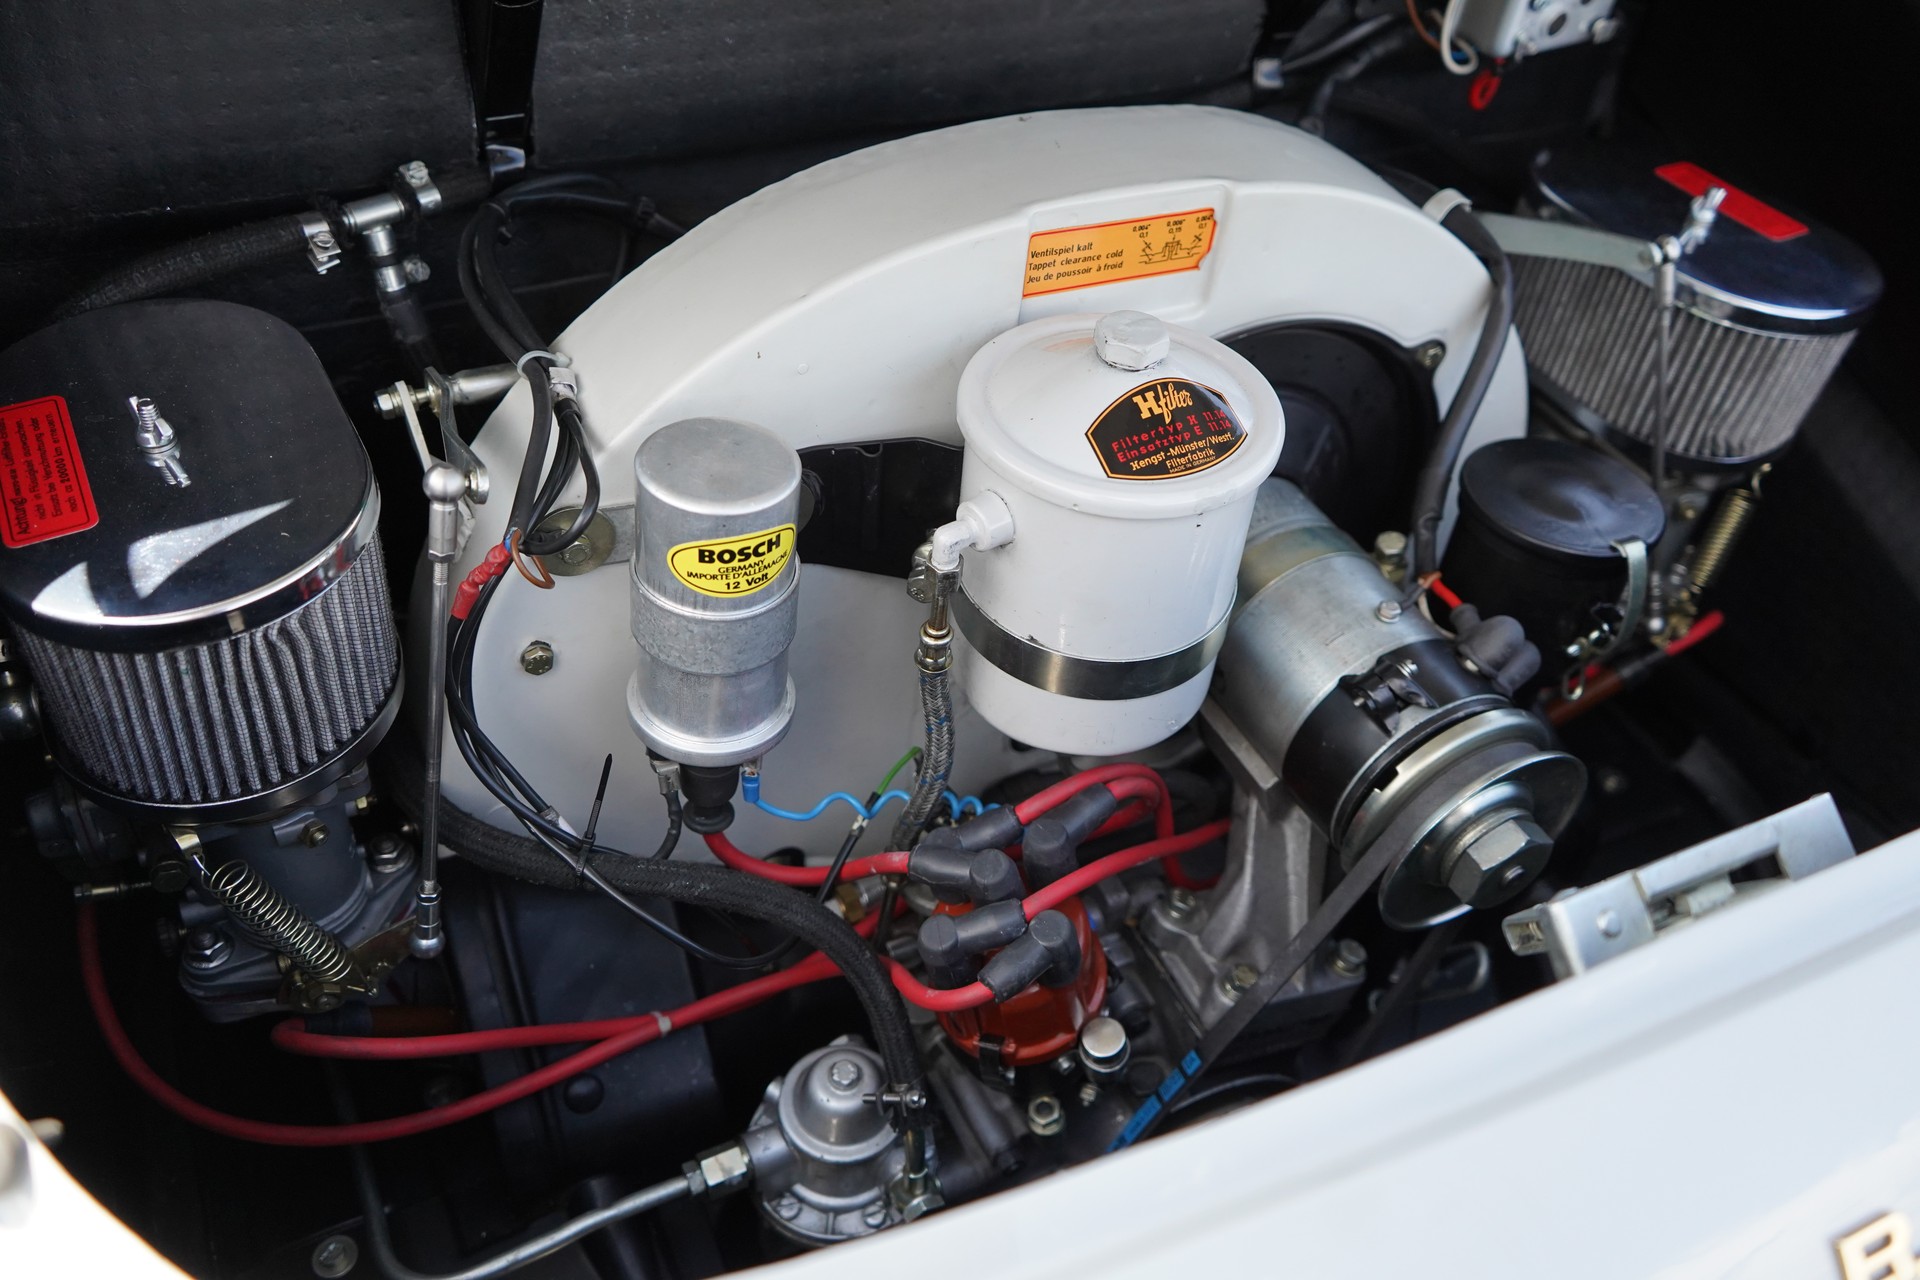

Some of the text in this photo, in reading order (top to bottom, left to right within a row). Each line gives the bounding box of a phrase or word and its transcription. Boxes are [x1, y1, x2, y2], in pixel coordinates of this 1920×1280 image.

[1028, 249, 1124, 271] Tappet clearance cold
[1030, 242, 1093, 259] Ventilspiel kalt
[1027, 260, 1124, 284] Jeu de poussoir à froid
[1112, 422, 1183, 452] Filtertyp
[1203, 409, 1226, 421] 11.14
[1117, 420, 1232, 463] Einsatztyp E 11.14
[54, 446, 64, 459] km
[1166, 448, 1216, 469] Filterfabrik
[54, 458, 71, 484] 20000
[698, 533, 780, 564] BOSCH
[687, 550, 788, 581] IMPORTE D'ALLEMAGNE
[718, 559, 765, 574] GERMANY
[725, 572, 769, 590] 12 Volt
